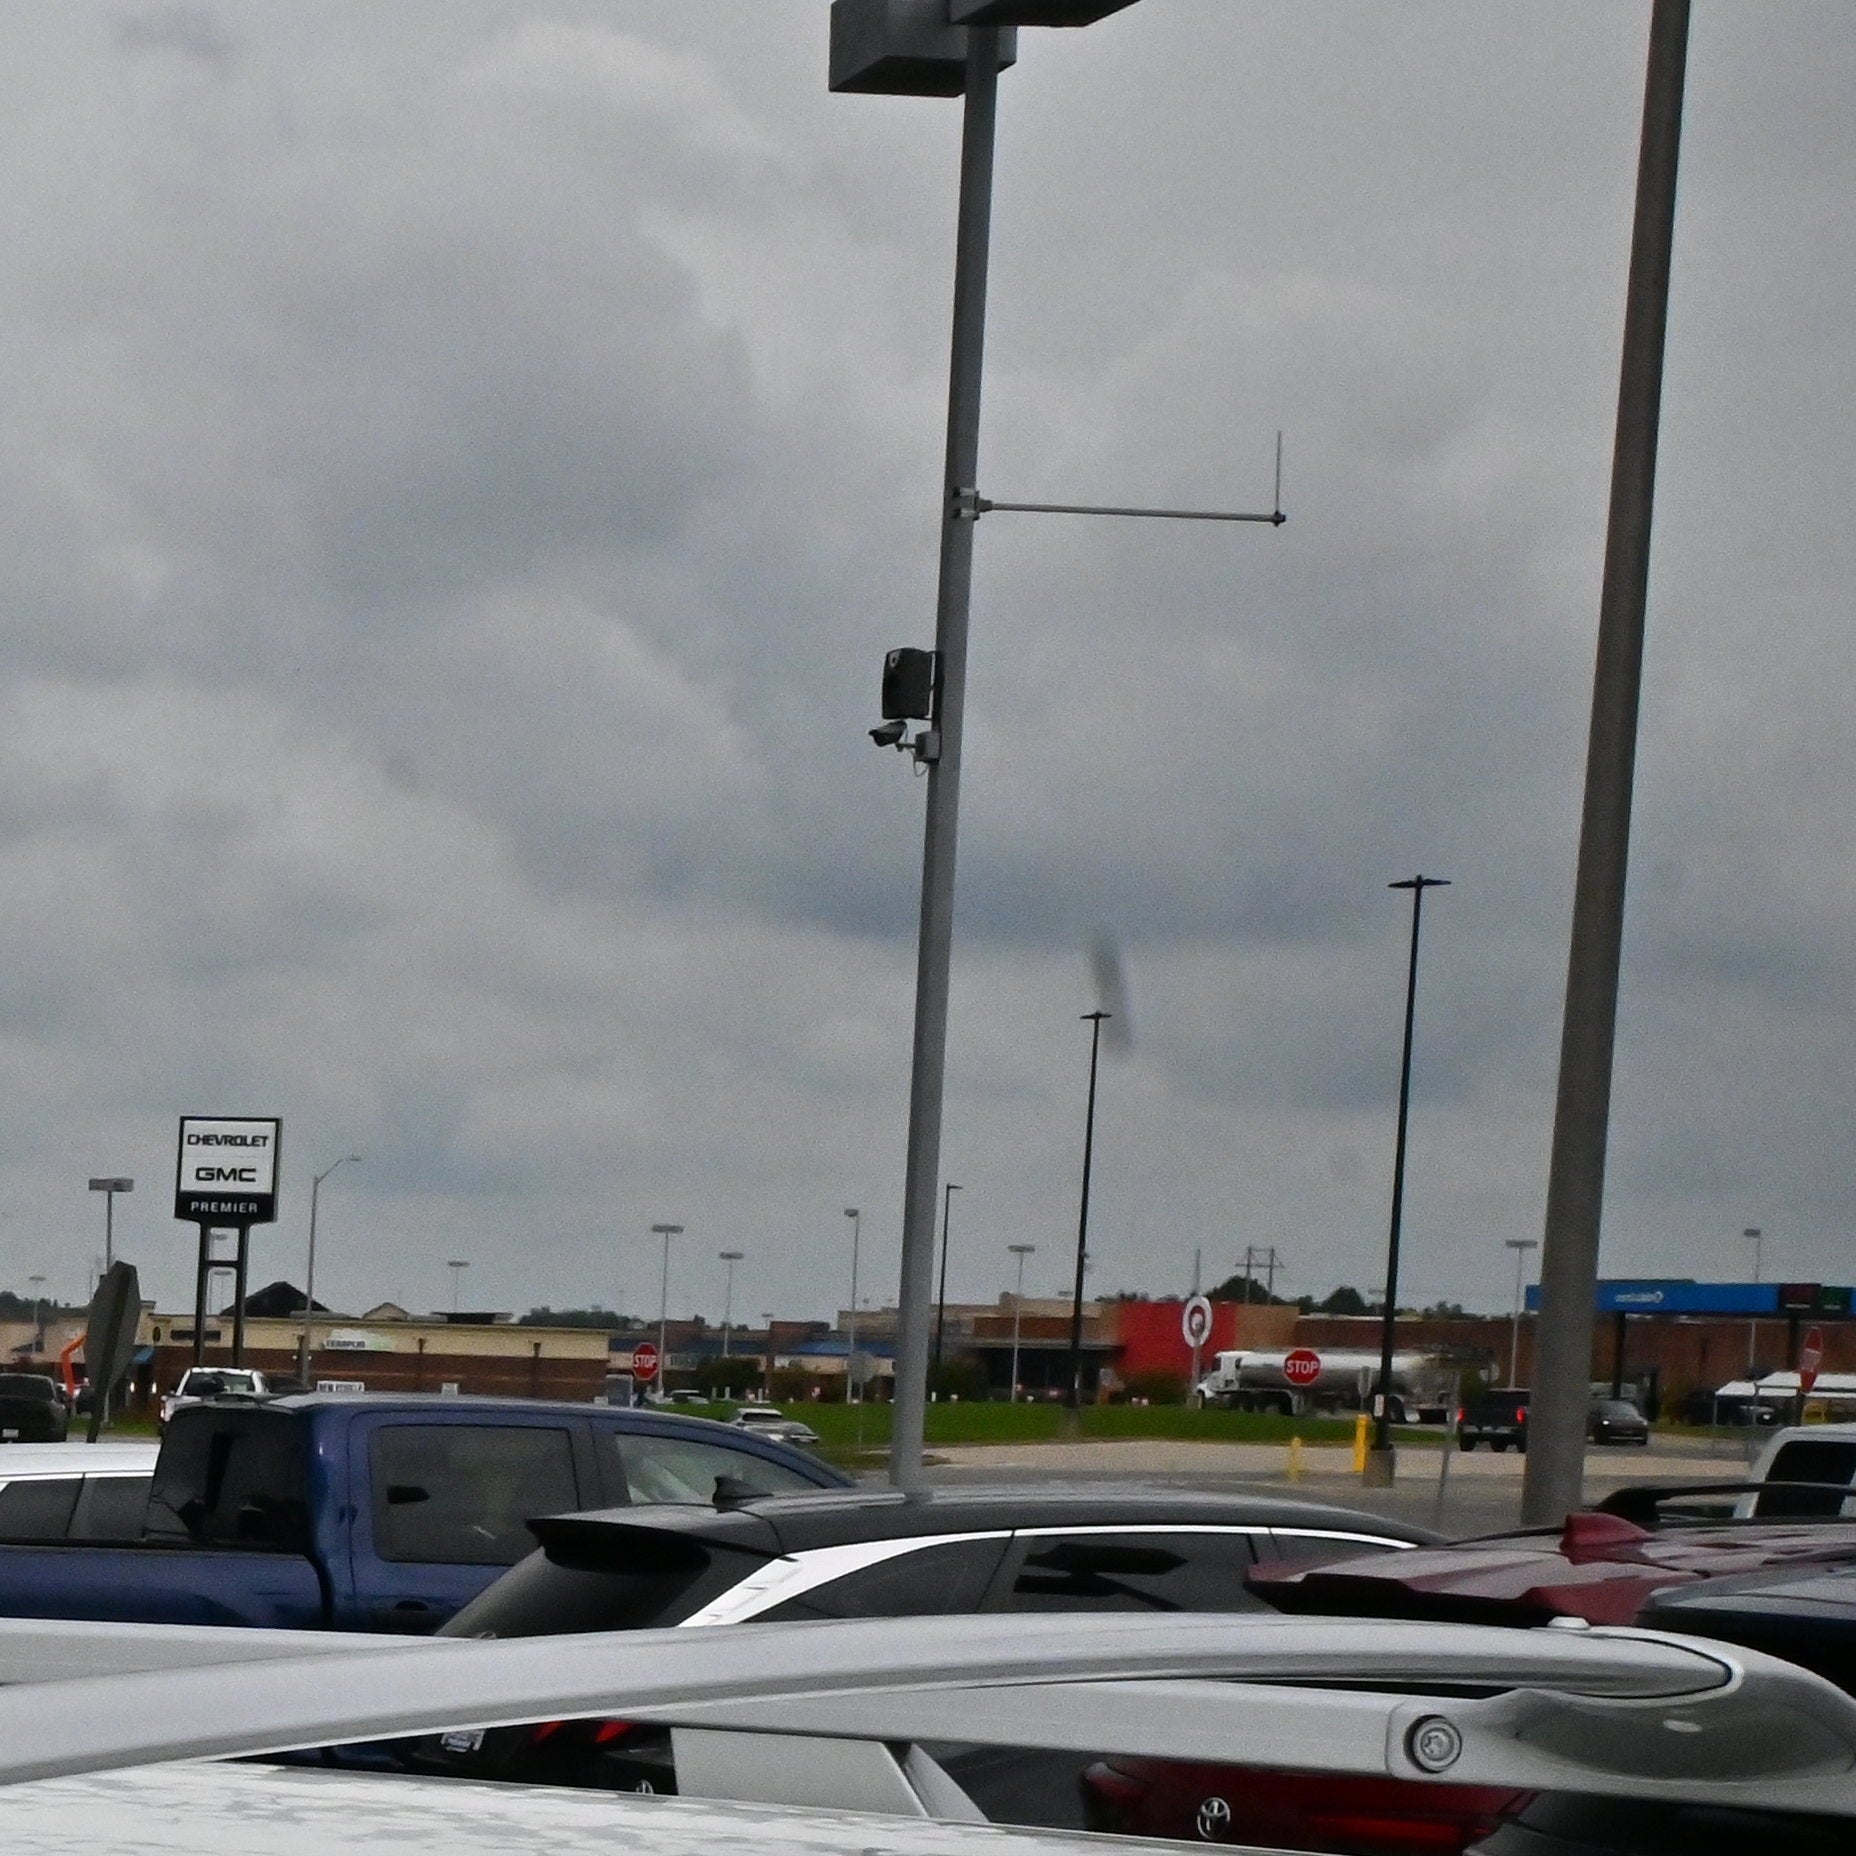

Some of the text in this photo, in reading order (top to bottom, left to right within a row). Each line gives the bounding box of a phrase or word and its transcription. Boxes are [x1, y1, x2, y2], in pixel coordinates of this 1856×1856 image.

[186, 1133, 269, 1148] CHEVROLET
[195, 1166, 257, 1182] GMC
[190, 1201, 258, 1213] PREMIER
[633, 1354, 657, 1368] STOP
[1286, 1359, 1320, 1374] STOP
